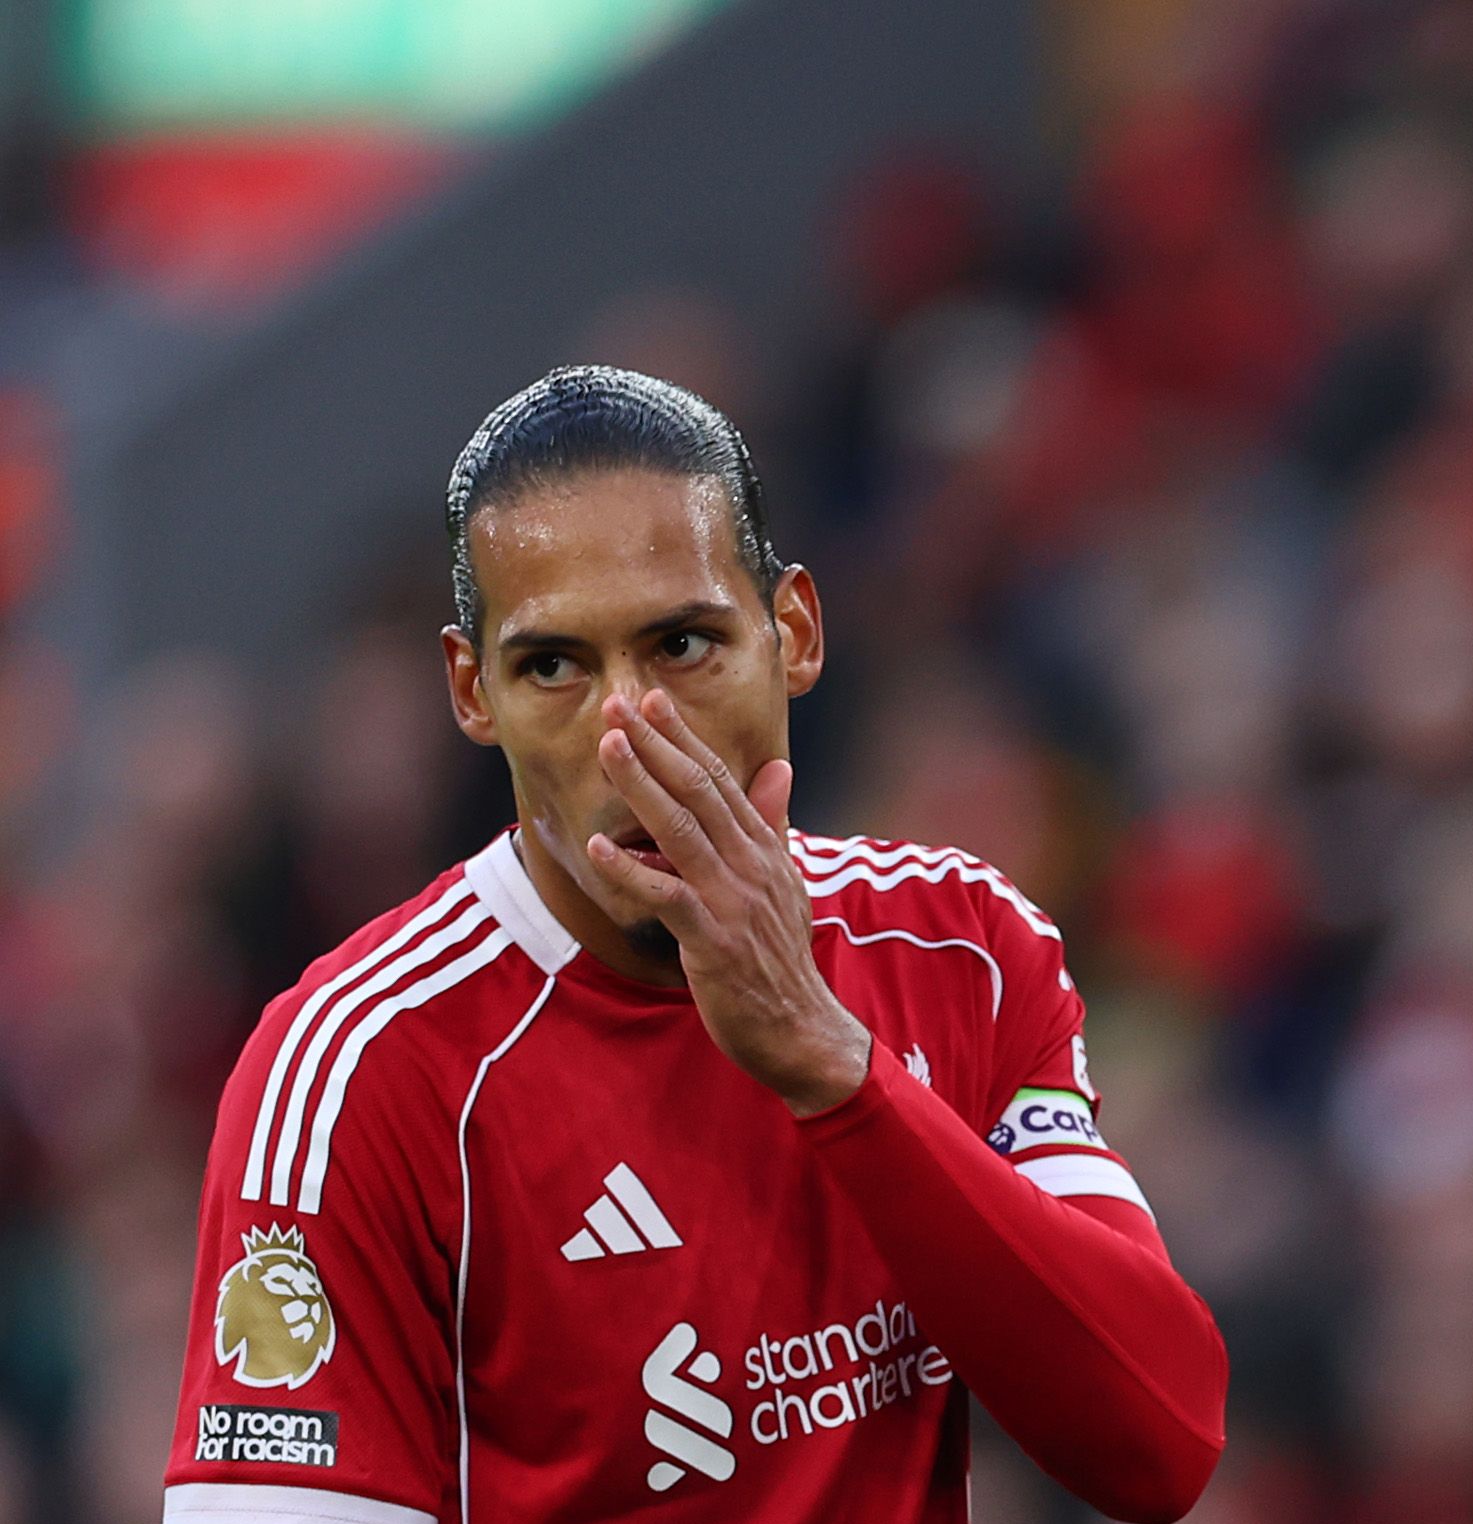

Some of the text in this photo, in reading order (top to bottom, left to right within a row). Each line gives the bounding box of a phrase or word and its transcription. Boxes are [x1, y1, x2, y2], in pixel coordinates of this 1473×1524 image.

[751, 1345, 953, 1444] chartere
[199, 1405, 323, 1441] No room
[231, 1434, 335, 1467] racism
